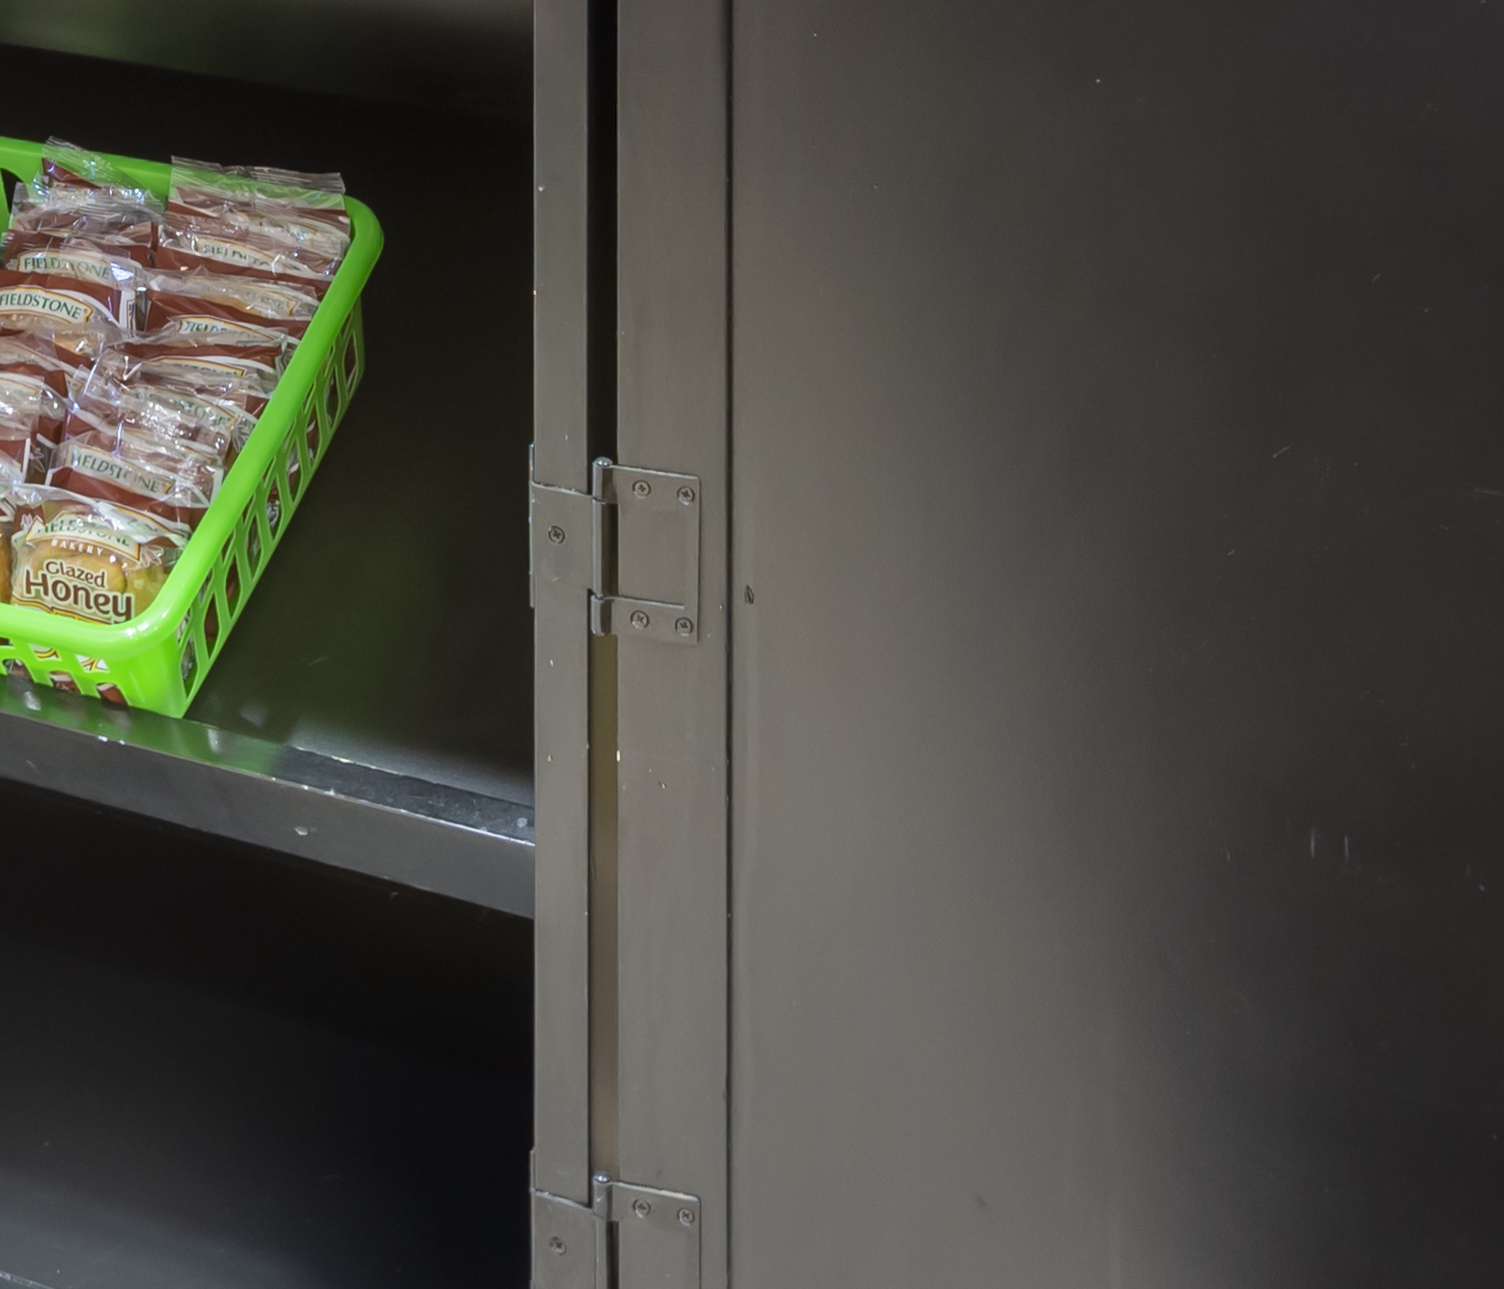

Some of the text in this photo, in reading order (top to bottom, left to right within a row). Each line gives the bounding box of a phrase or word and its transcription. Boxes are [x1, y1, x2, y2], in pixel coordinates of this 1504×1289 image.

[51, 539, 103, 556] BAKERY
[45, 561, 106, 589] Glazed
[25, 569, 132, 624] Honey
